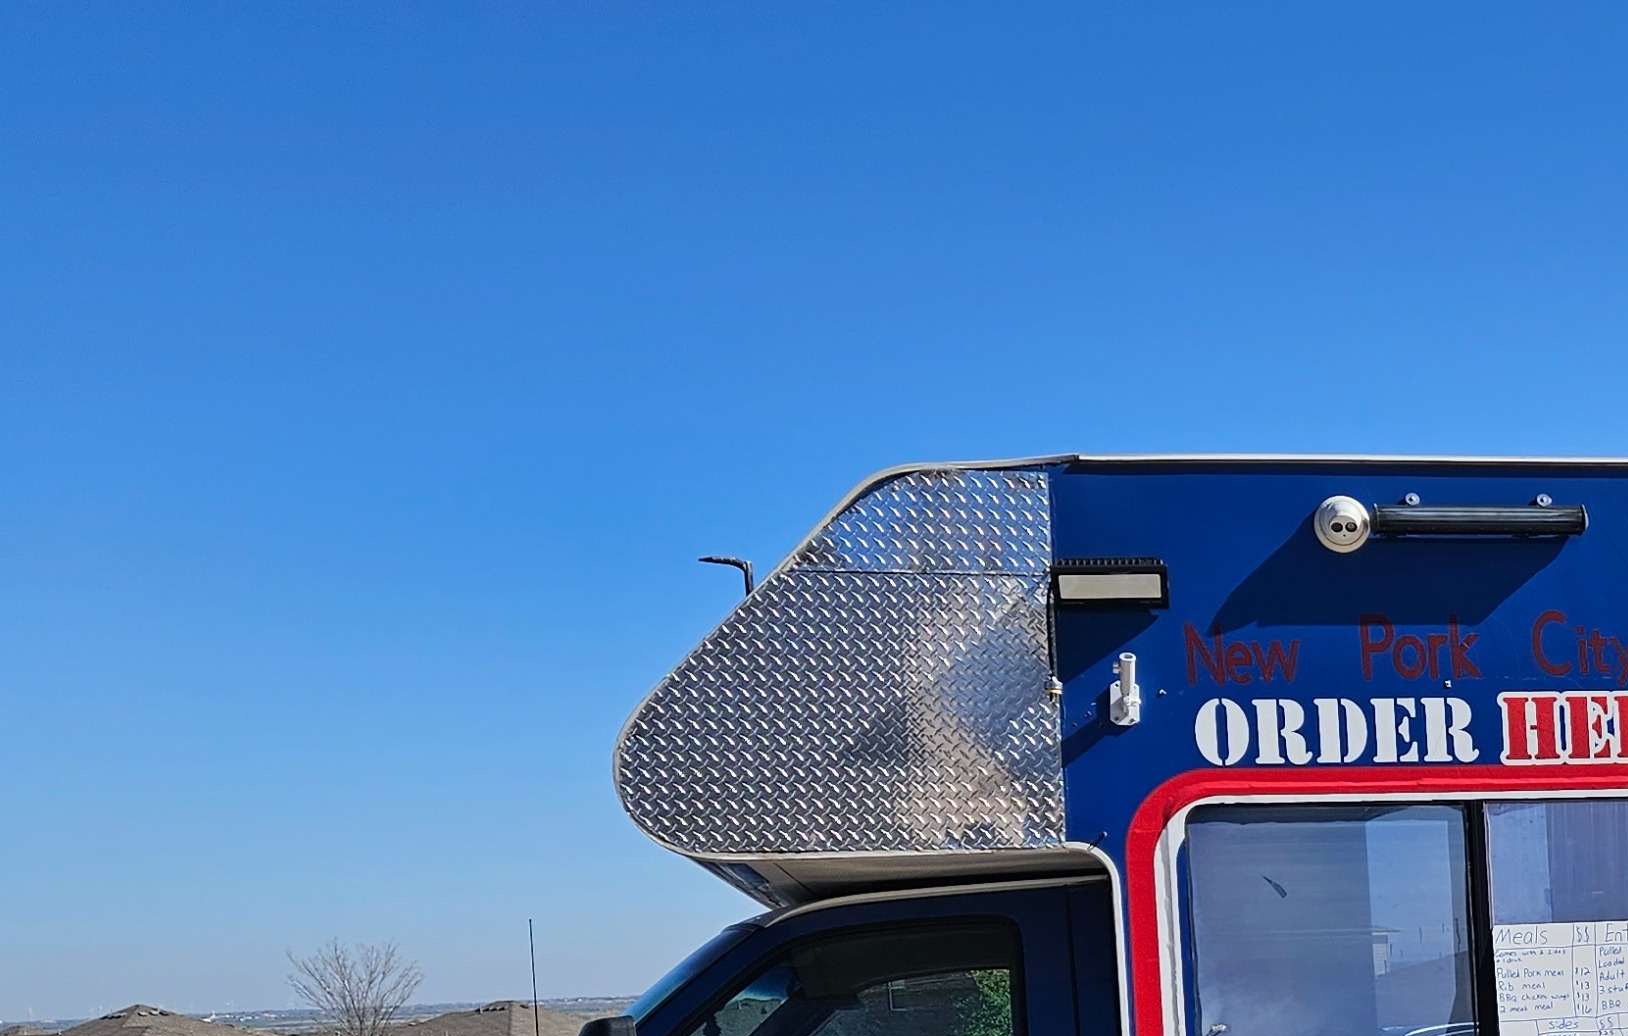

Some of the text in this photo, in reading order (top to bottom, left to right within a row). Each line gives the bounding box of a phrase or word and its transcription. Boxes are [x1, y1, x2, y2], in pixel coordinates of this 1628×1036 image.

[1184, 621, 1300, 686] New
[1359, 614, 1484, 681] Pork
[1195, 697, 1480, 767] ORDER
[1495, 925, 1548, 946] Meals
